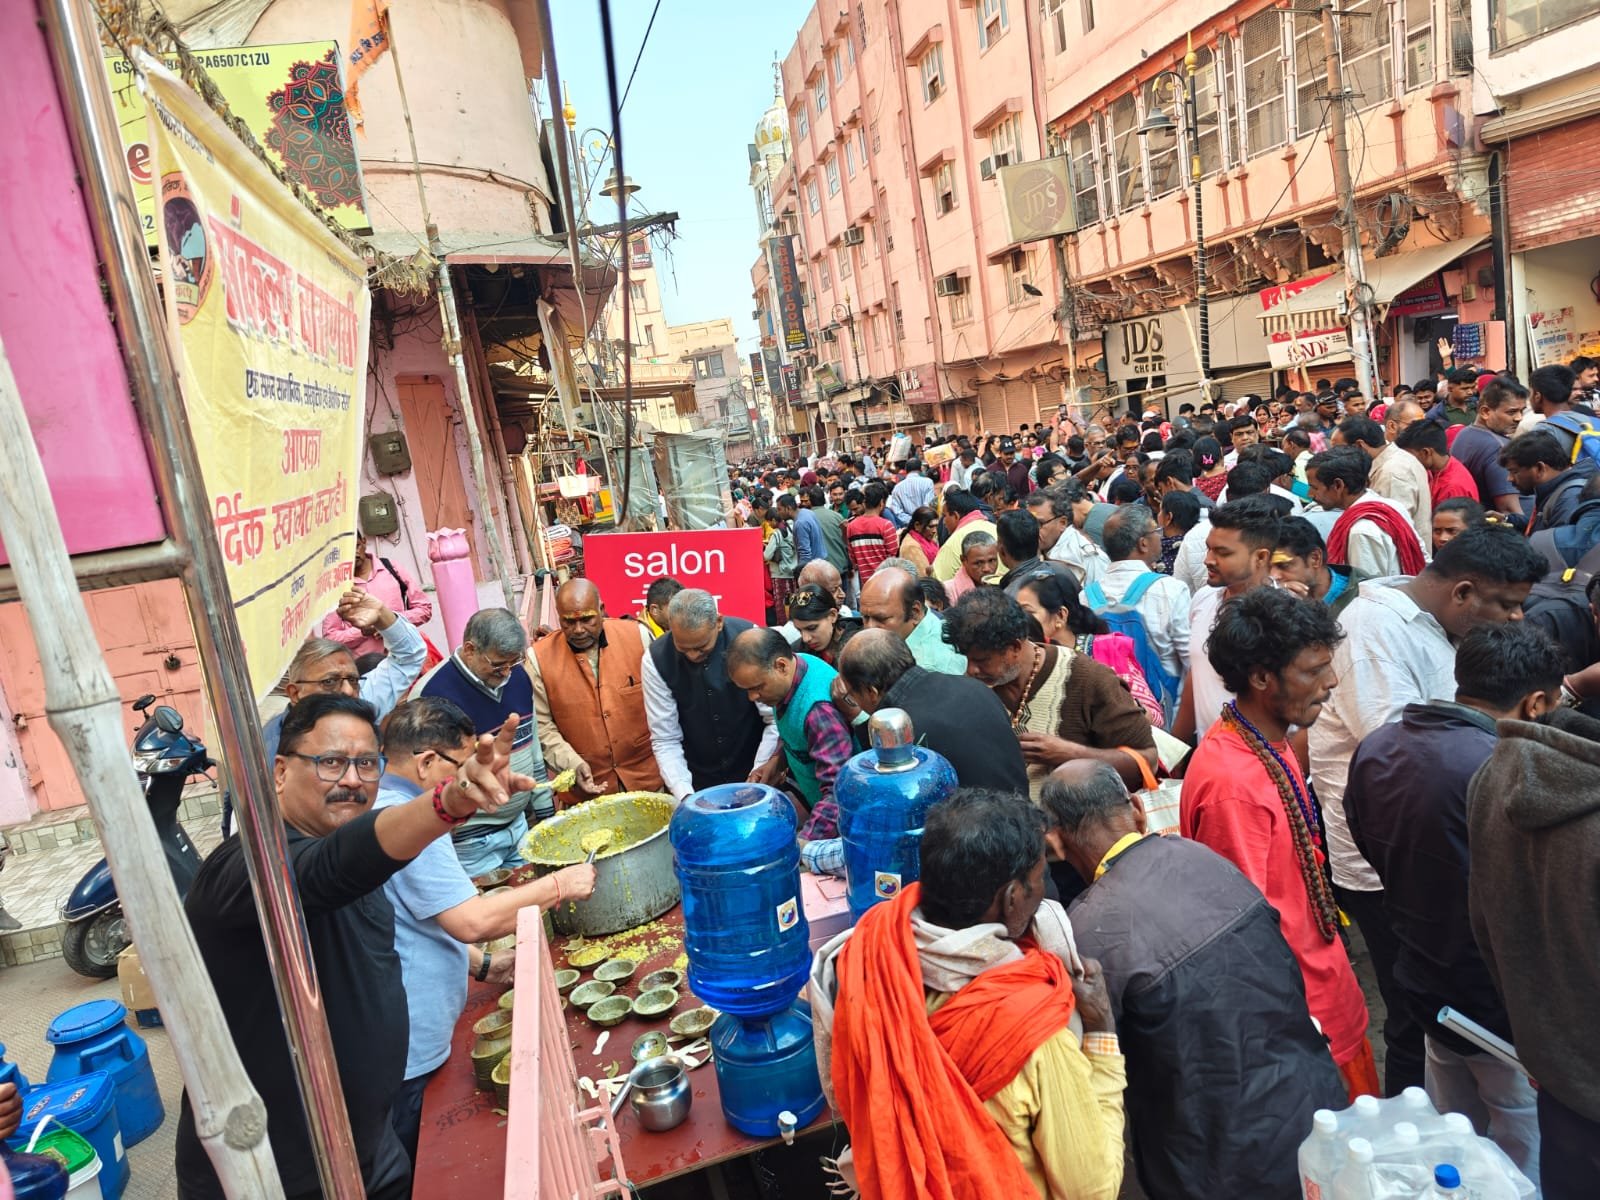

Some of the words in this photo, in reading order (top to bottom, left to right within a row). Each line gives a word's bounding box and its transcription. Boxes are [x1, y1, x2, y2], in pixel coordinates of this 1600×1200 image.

[1019, 176, 1058, 223] JDS
[1120, 318, 1163, 365] JDS
[281, 429, 322, 474] आपका
[271, 494, 314, 550] स्वागत
[624, 543, 725, 578] salon
